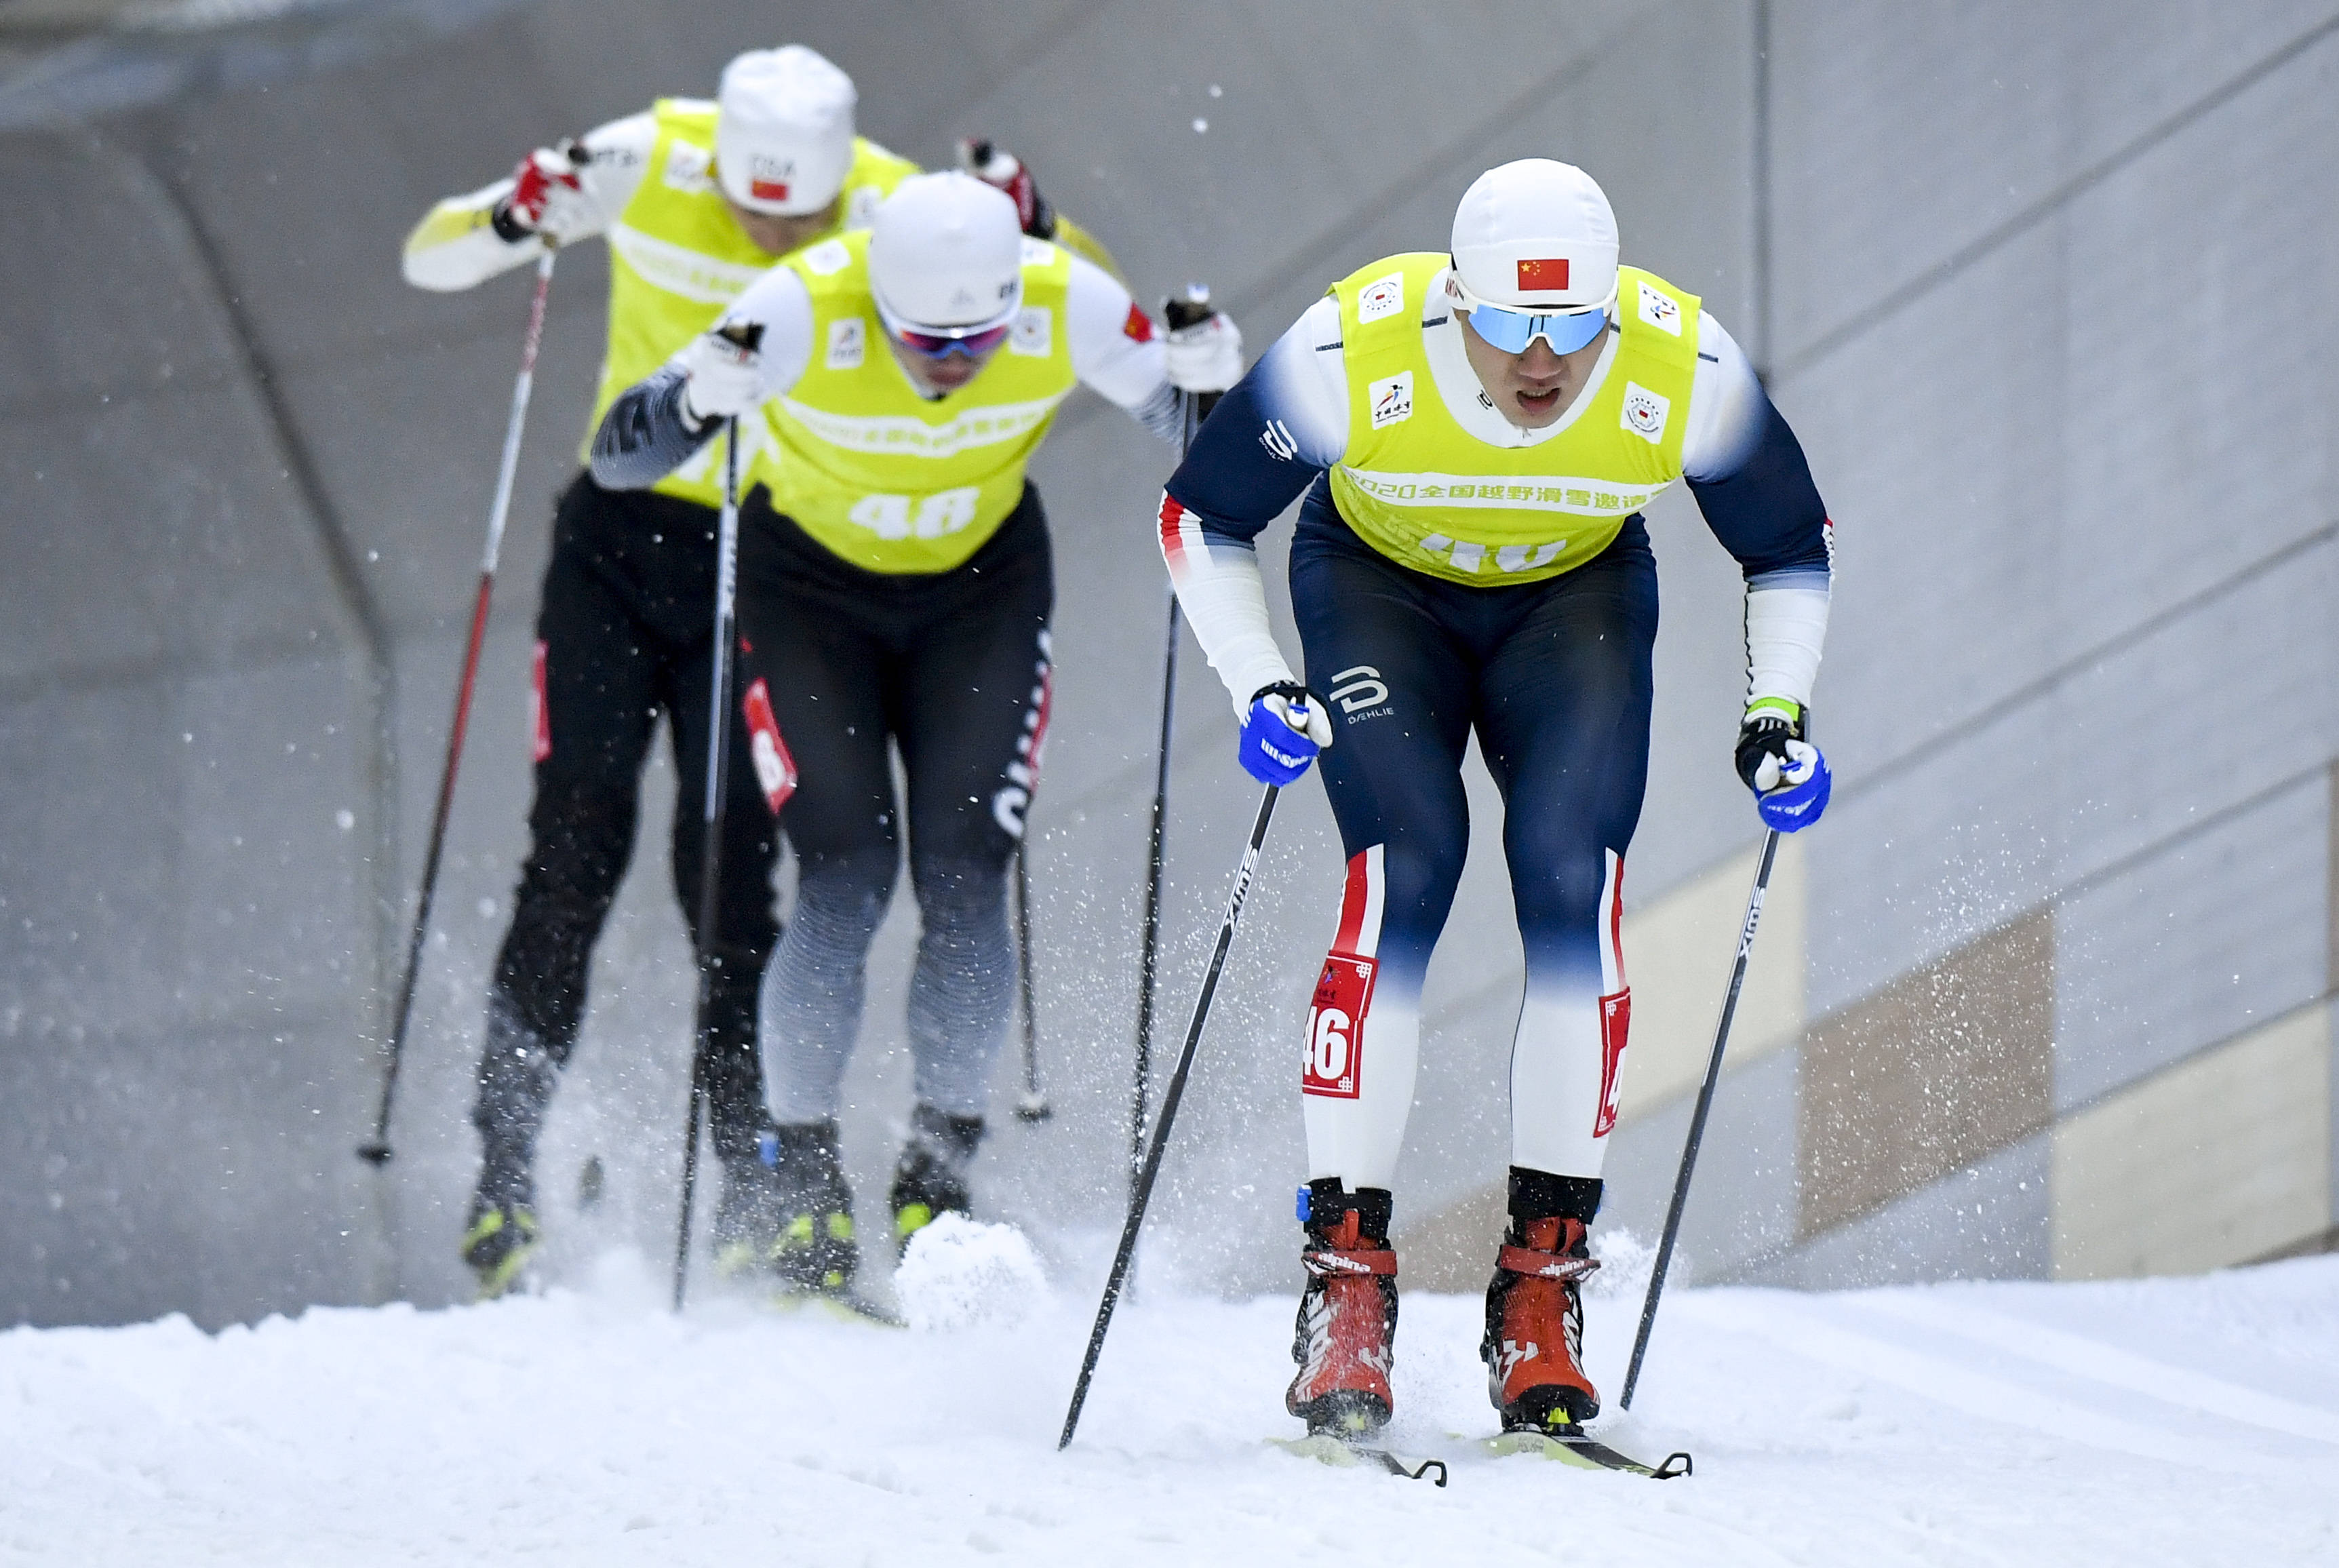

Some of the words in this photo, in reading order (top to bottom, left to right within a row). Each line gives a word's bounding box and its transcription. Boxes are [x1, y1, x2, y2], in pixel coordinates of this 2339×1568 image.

[1302, 1005, 1350, 1080] 46
[1318, 1253, 1371, 1273] alpina
[1538, 1259, 1586, 1276] alpina
